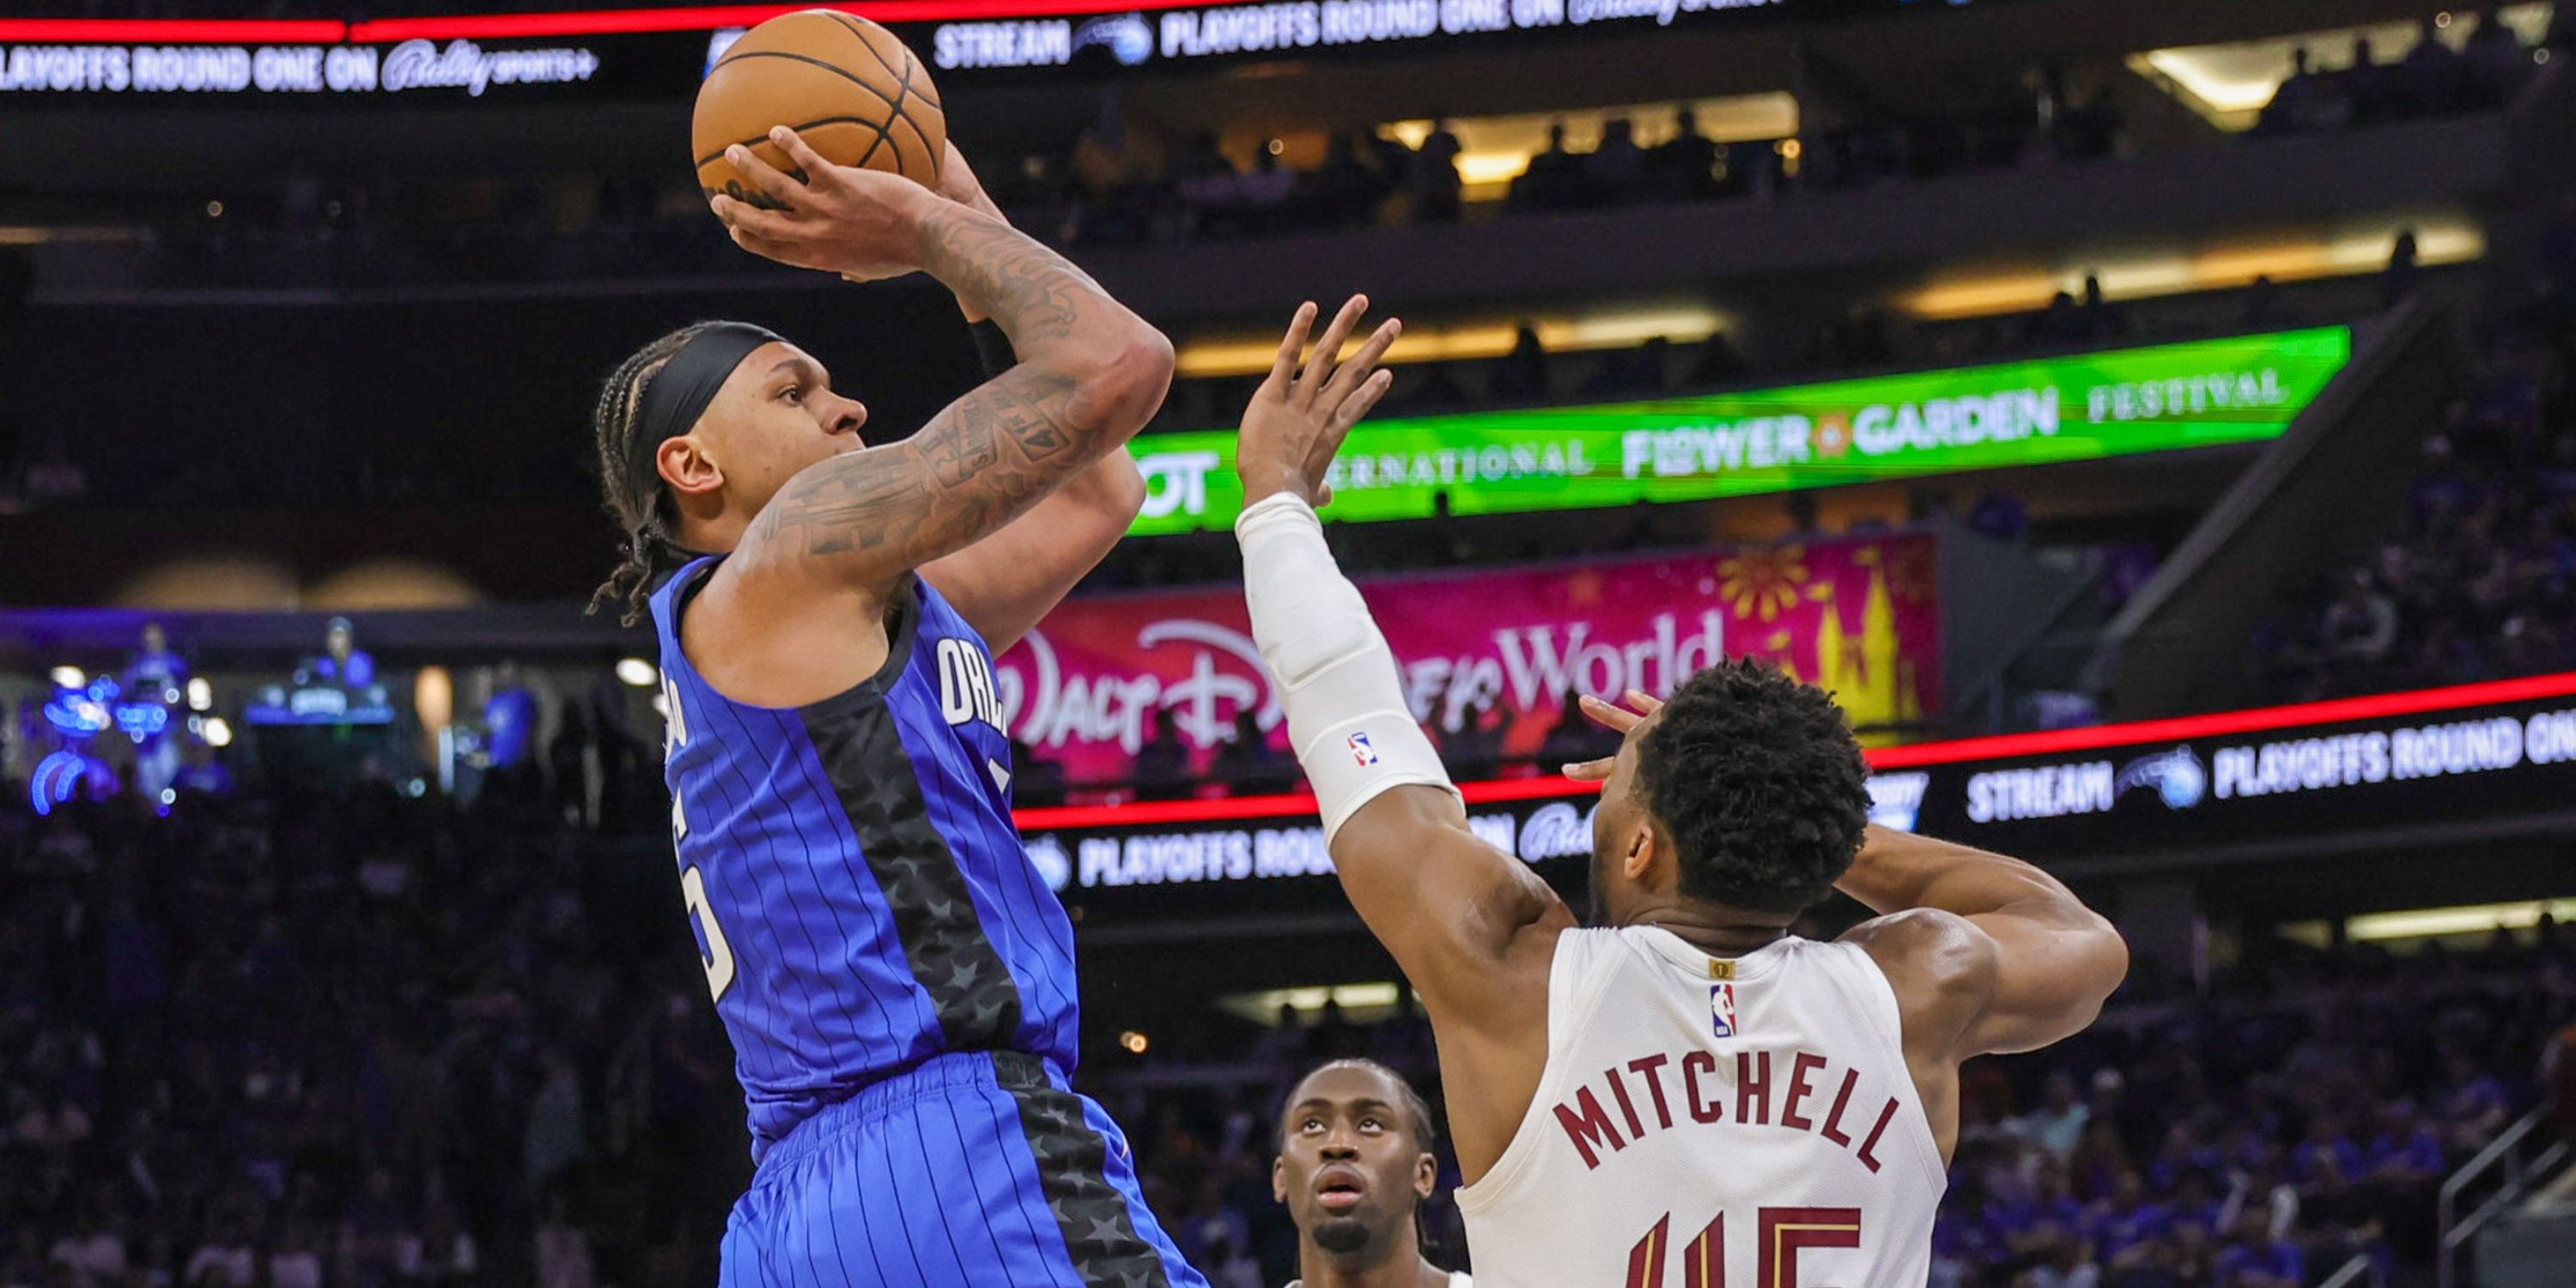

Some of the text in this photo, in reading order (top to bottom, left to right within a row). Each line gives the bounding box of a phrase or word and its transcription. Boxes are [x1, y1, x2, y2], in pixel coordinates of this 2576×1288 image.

[131, 46, 252, 92] ROUND
[252, 46, 324, 92] ONE
[325, 46, 378, 92] ON
[933, 20, 1072, 70] STREAM
[1160, 1, 1320, 58] PLAYOFFS
[1321, 0, 1439, 45] ROUND
[1622, 415, 1812, 480] FLOWER
[1851, 386, 2060, 456] GARDEN
[2087, 366, 2291, 424] FESTIVAL
[1492, 606, 1723, 713] World
[1967, 760, 2115, 823] STREAM
[2214, 731, 2390, 799] PLAYOFFS
[2391, 715, 2524, 781] ROUND
[1078, 829, 1252, 888] PLAYOFFS
[1552, 1050, 1901, 1175] MITCHELL
